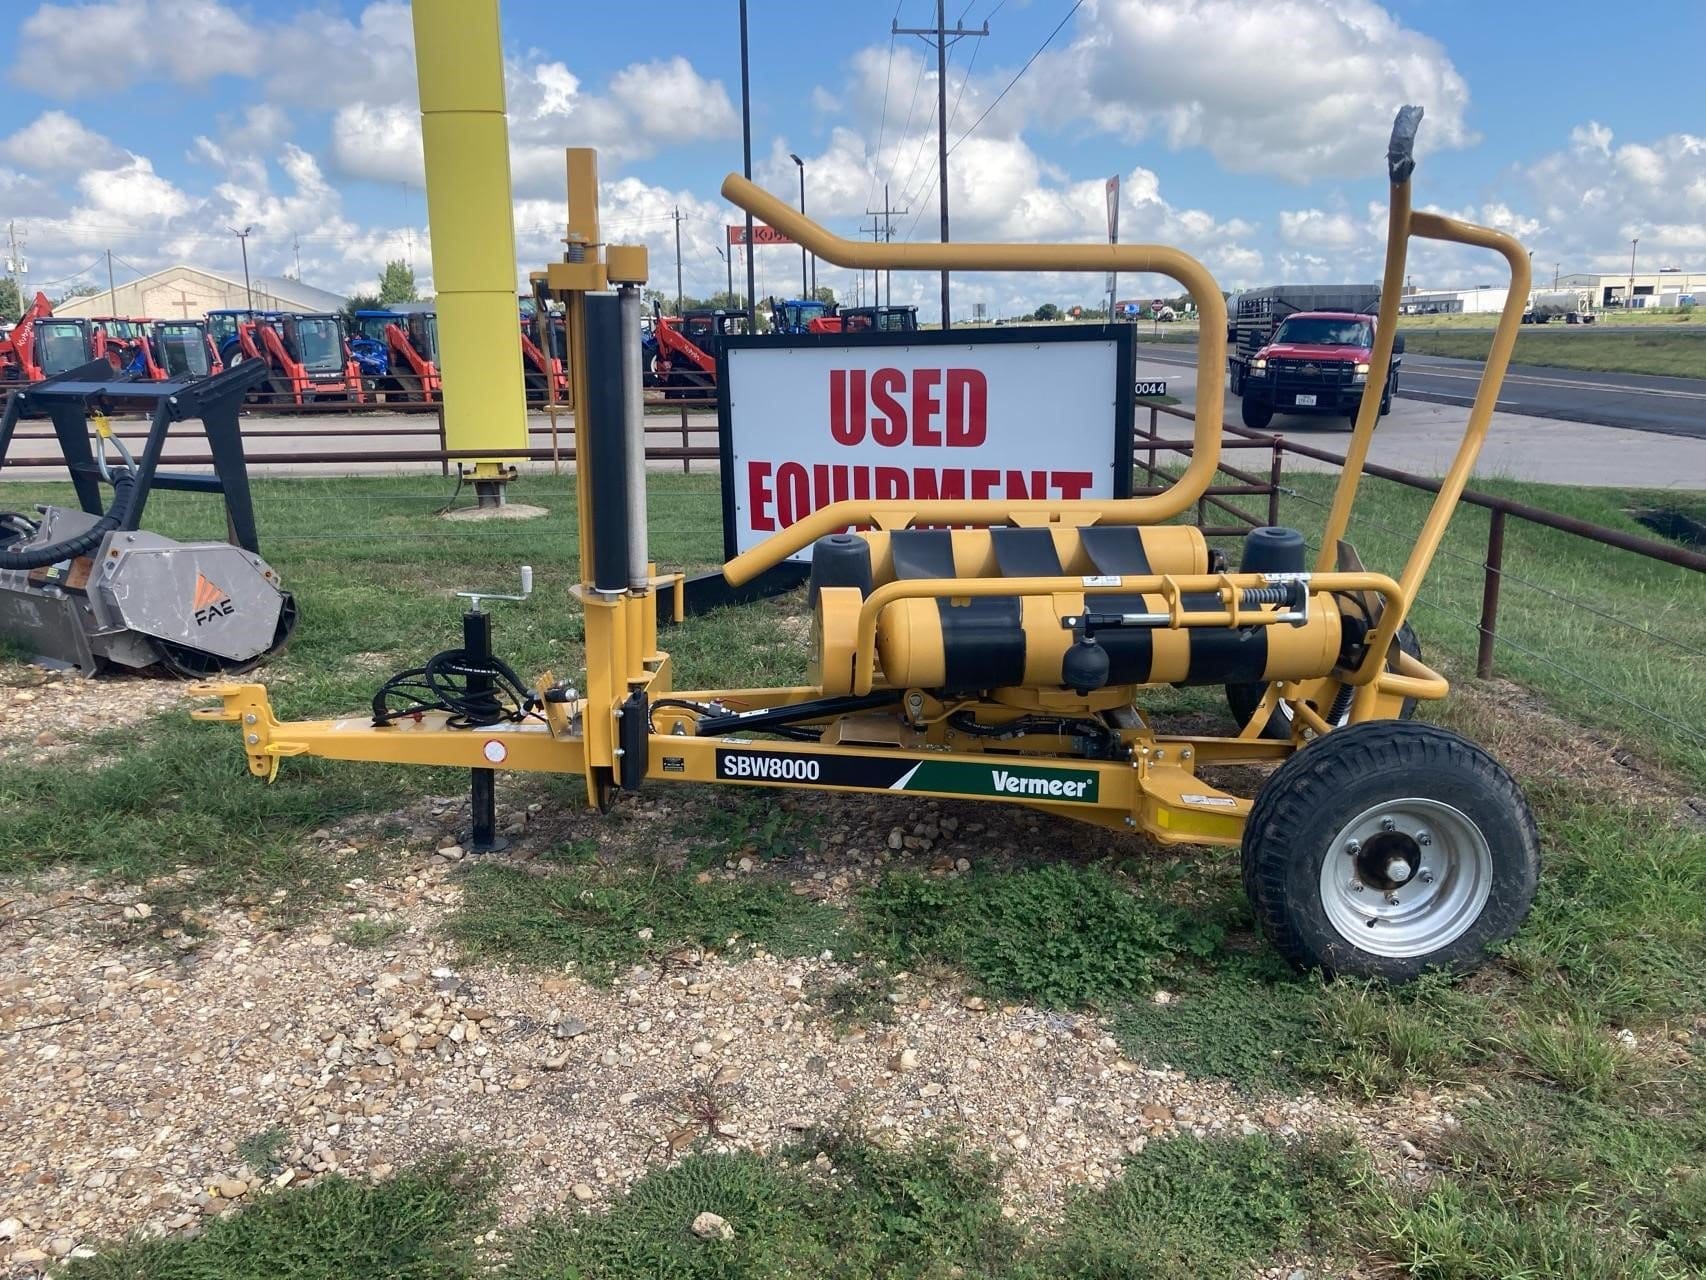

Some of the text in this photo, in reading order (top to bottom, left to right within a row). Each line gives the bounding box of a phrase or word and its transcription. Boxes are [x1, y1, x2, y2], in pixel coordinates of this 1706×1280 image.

[1135, 383, 1165, 394] 0044
[829, 367, 988, 448] USED
[194, 599, 235, 626] FAE
[723, 755, 820, 781] SBW8000
[991, 770, 1086, 797] Vermeer
